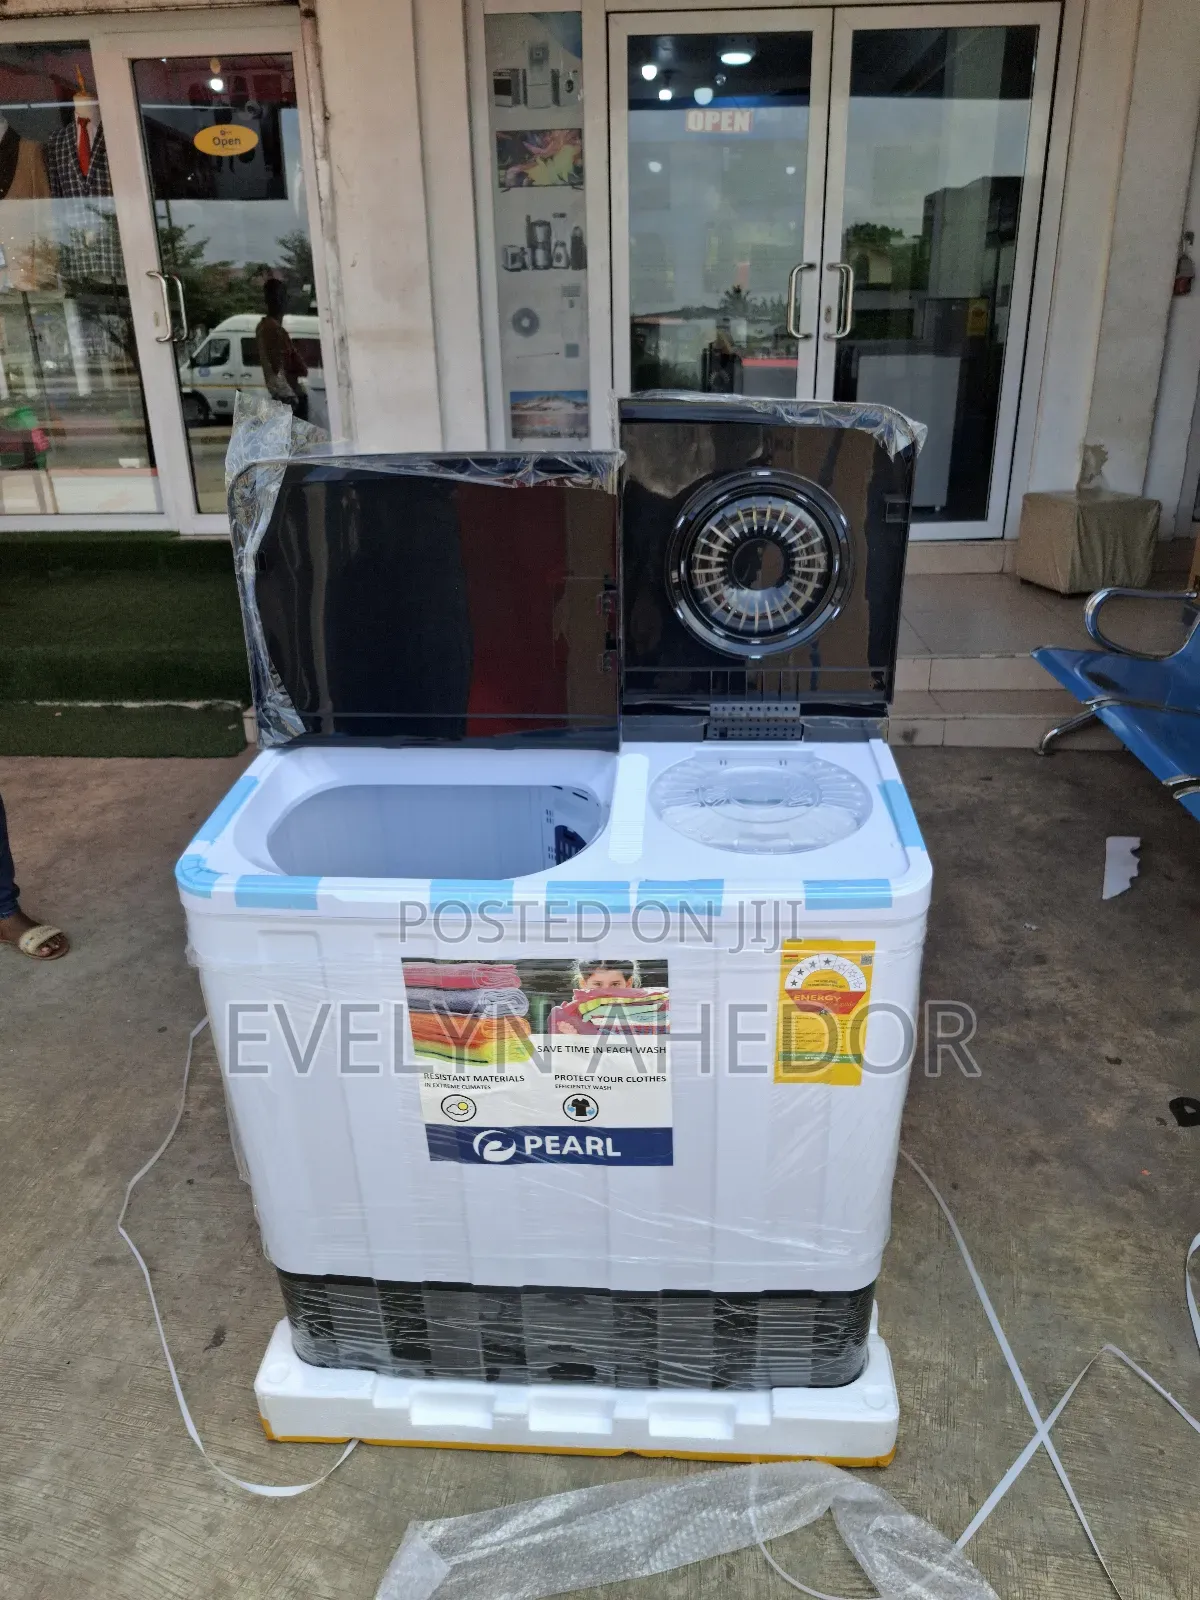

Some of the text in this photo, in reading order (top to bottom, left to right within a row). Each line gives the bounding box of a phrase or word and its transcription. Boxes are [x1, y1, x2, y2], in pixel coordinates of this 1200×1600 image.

[687, 110, 750, 131] OPEN
[212, 136, 241, 148] Open
[793, 994, 841, 1002] ENERGY
[537, 1045, 563, 1053] SAVE
[565, 1045, 590, 1053] TIME
[606, 1046, 632, 1054] EACH
[635, 1046, 666, 1054] WASH
[424, 1072, 525, 1083] RESISTANT MATERIALS
[554, 1074, 667, 1083] PROTECT YOUR CLOTHES
[523, 1135, 622, 1157] PEARL
